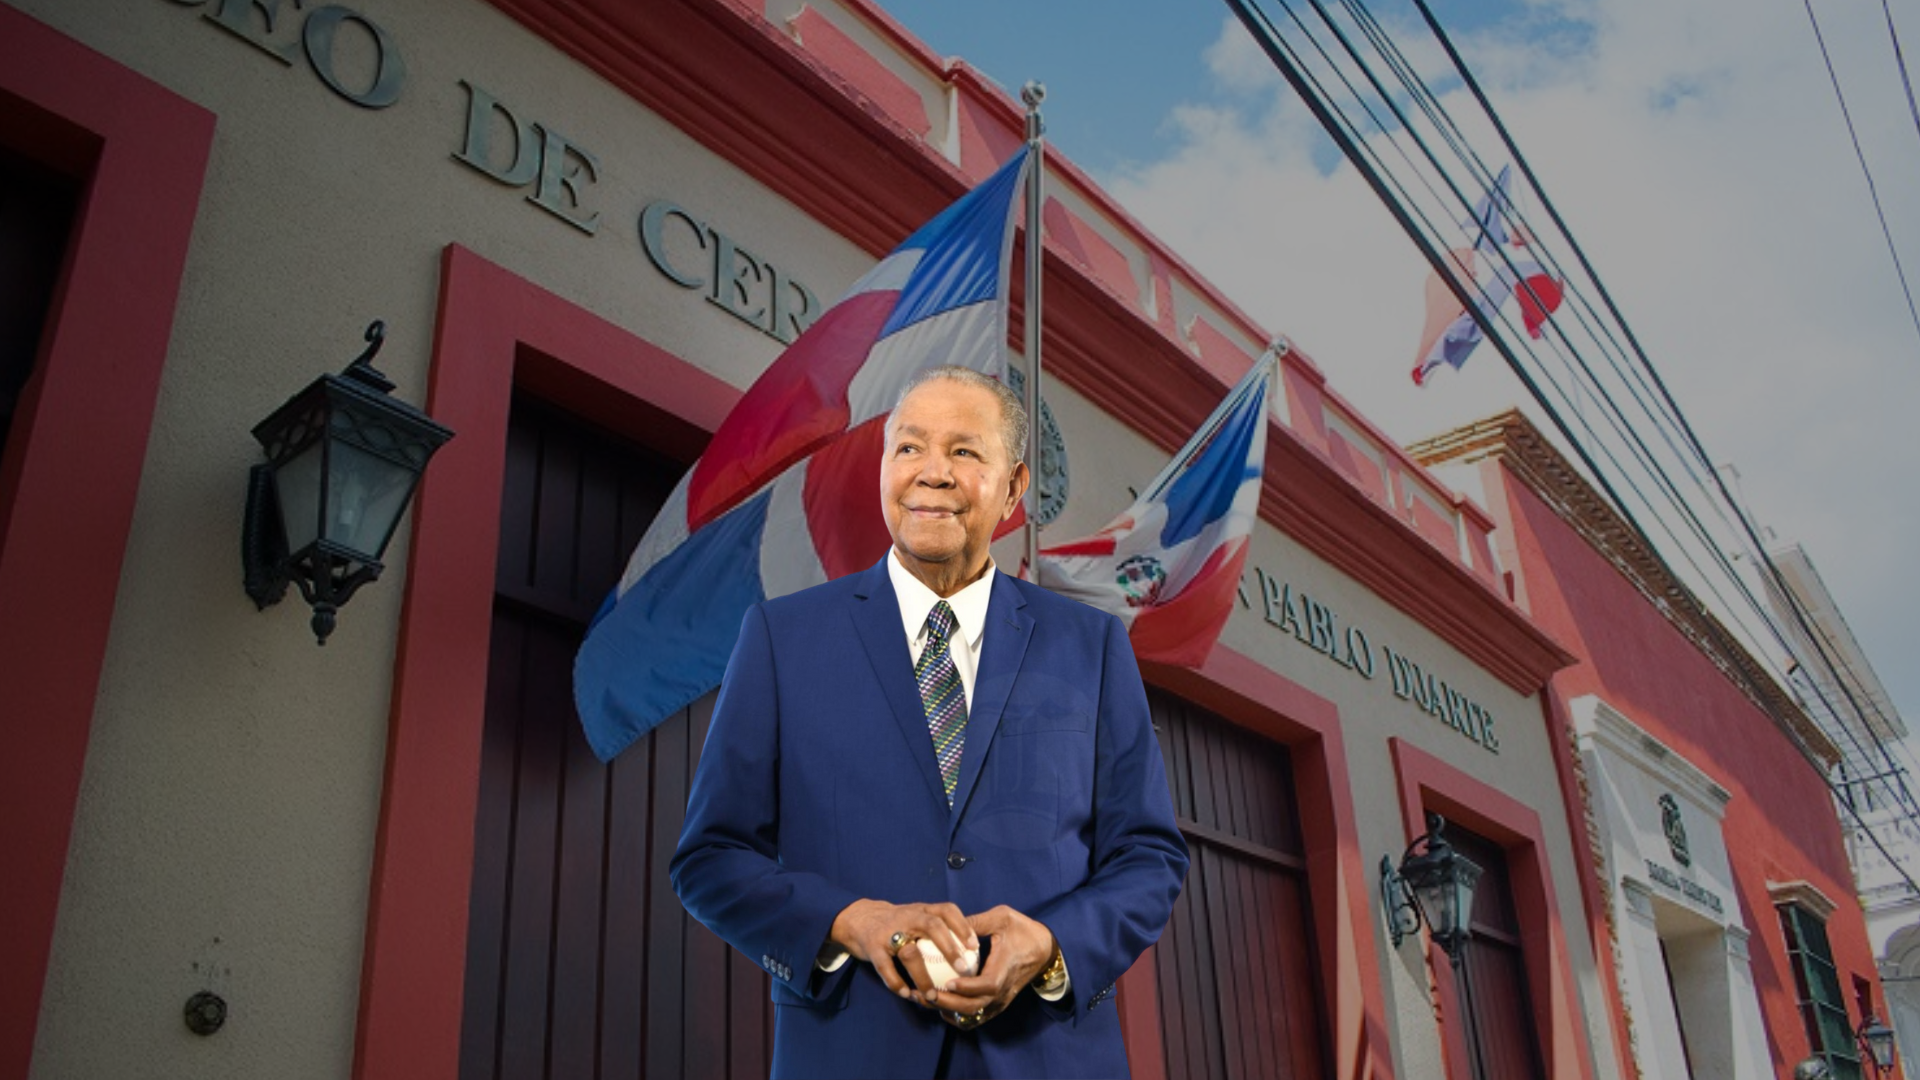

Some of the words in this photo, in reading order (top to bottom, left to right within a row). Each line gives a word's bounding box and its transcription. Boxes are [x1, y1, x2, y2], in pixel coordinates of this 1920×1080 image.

[164, 0, 405, 110] EO
[450, 79, 600, 237] DE
[1255, 567, 1375, 680] PABLO
[1383, 645, 1500, 754] DUARTE
